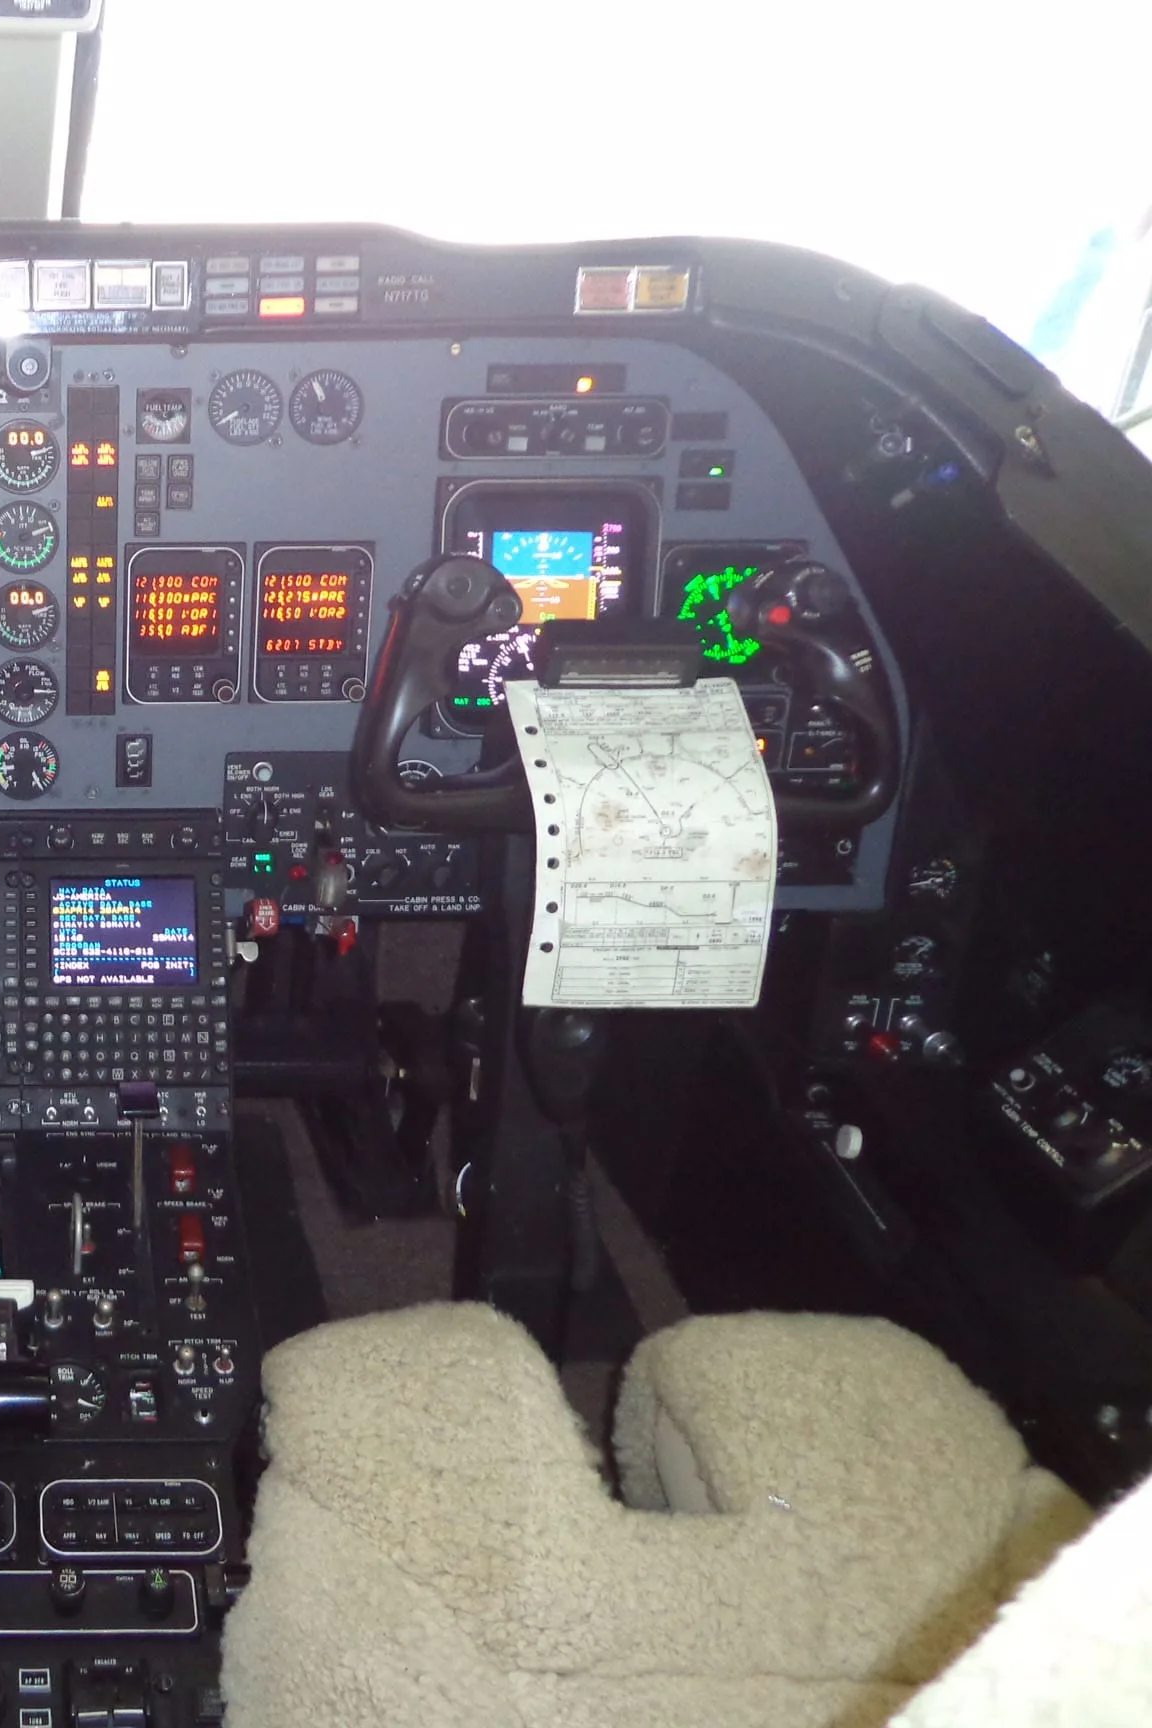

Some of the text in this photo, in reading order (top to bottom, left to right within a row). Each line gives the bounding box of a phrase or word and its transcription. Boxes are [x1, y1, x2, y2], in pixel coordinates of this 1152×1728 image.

[378, 275, 434, 286] RADIO CALL
[162, 404, 183, 412] TEMP
[8, 432, 44, 446] 00.0
[191, 576, 218, 588] COM
[319, 575, 348, 587] COM
[10, 591, 44, 605] 00.0
[191, 592, 216, 605] PRE
[319, 591, 345, 603] PRE
[266, 638, 342, 651] 6207 STBY
[105, 879, 141, 887] STATUS
[404, 896, 430, 904] CABIN
[459, 895, 466, 903] &
[282, 904, 306, 912] CABIN
[389, 904, 409, 912] TAKE
[412, 904, 430, 912] OFF
[441, 904, 461, 912] LAND
[54, 975, 154, 984] GPS NOT AVAILABLE
